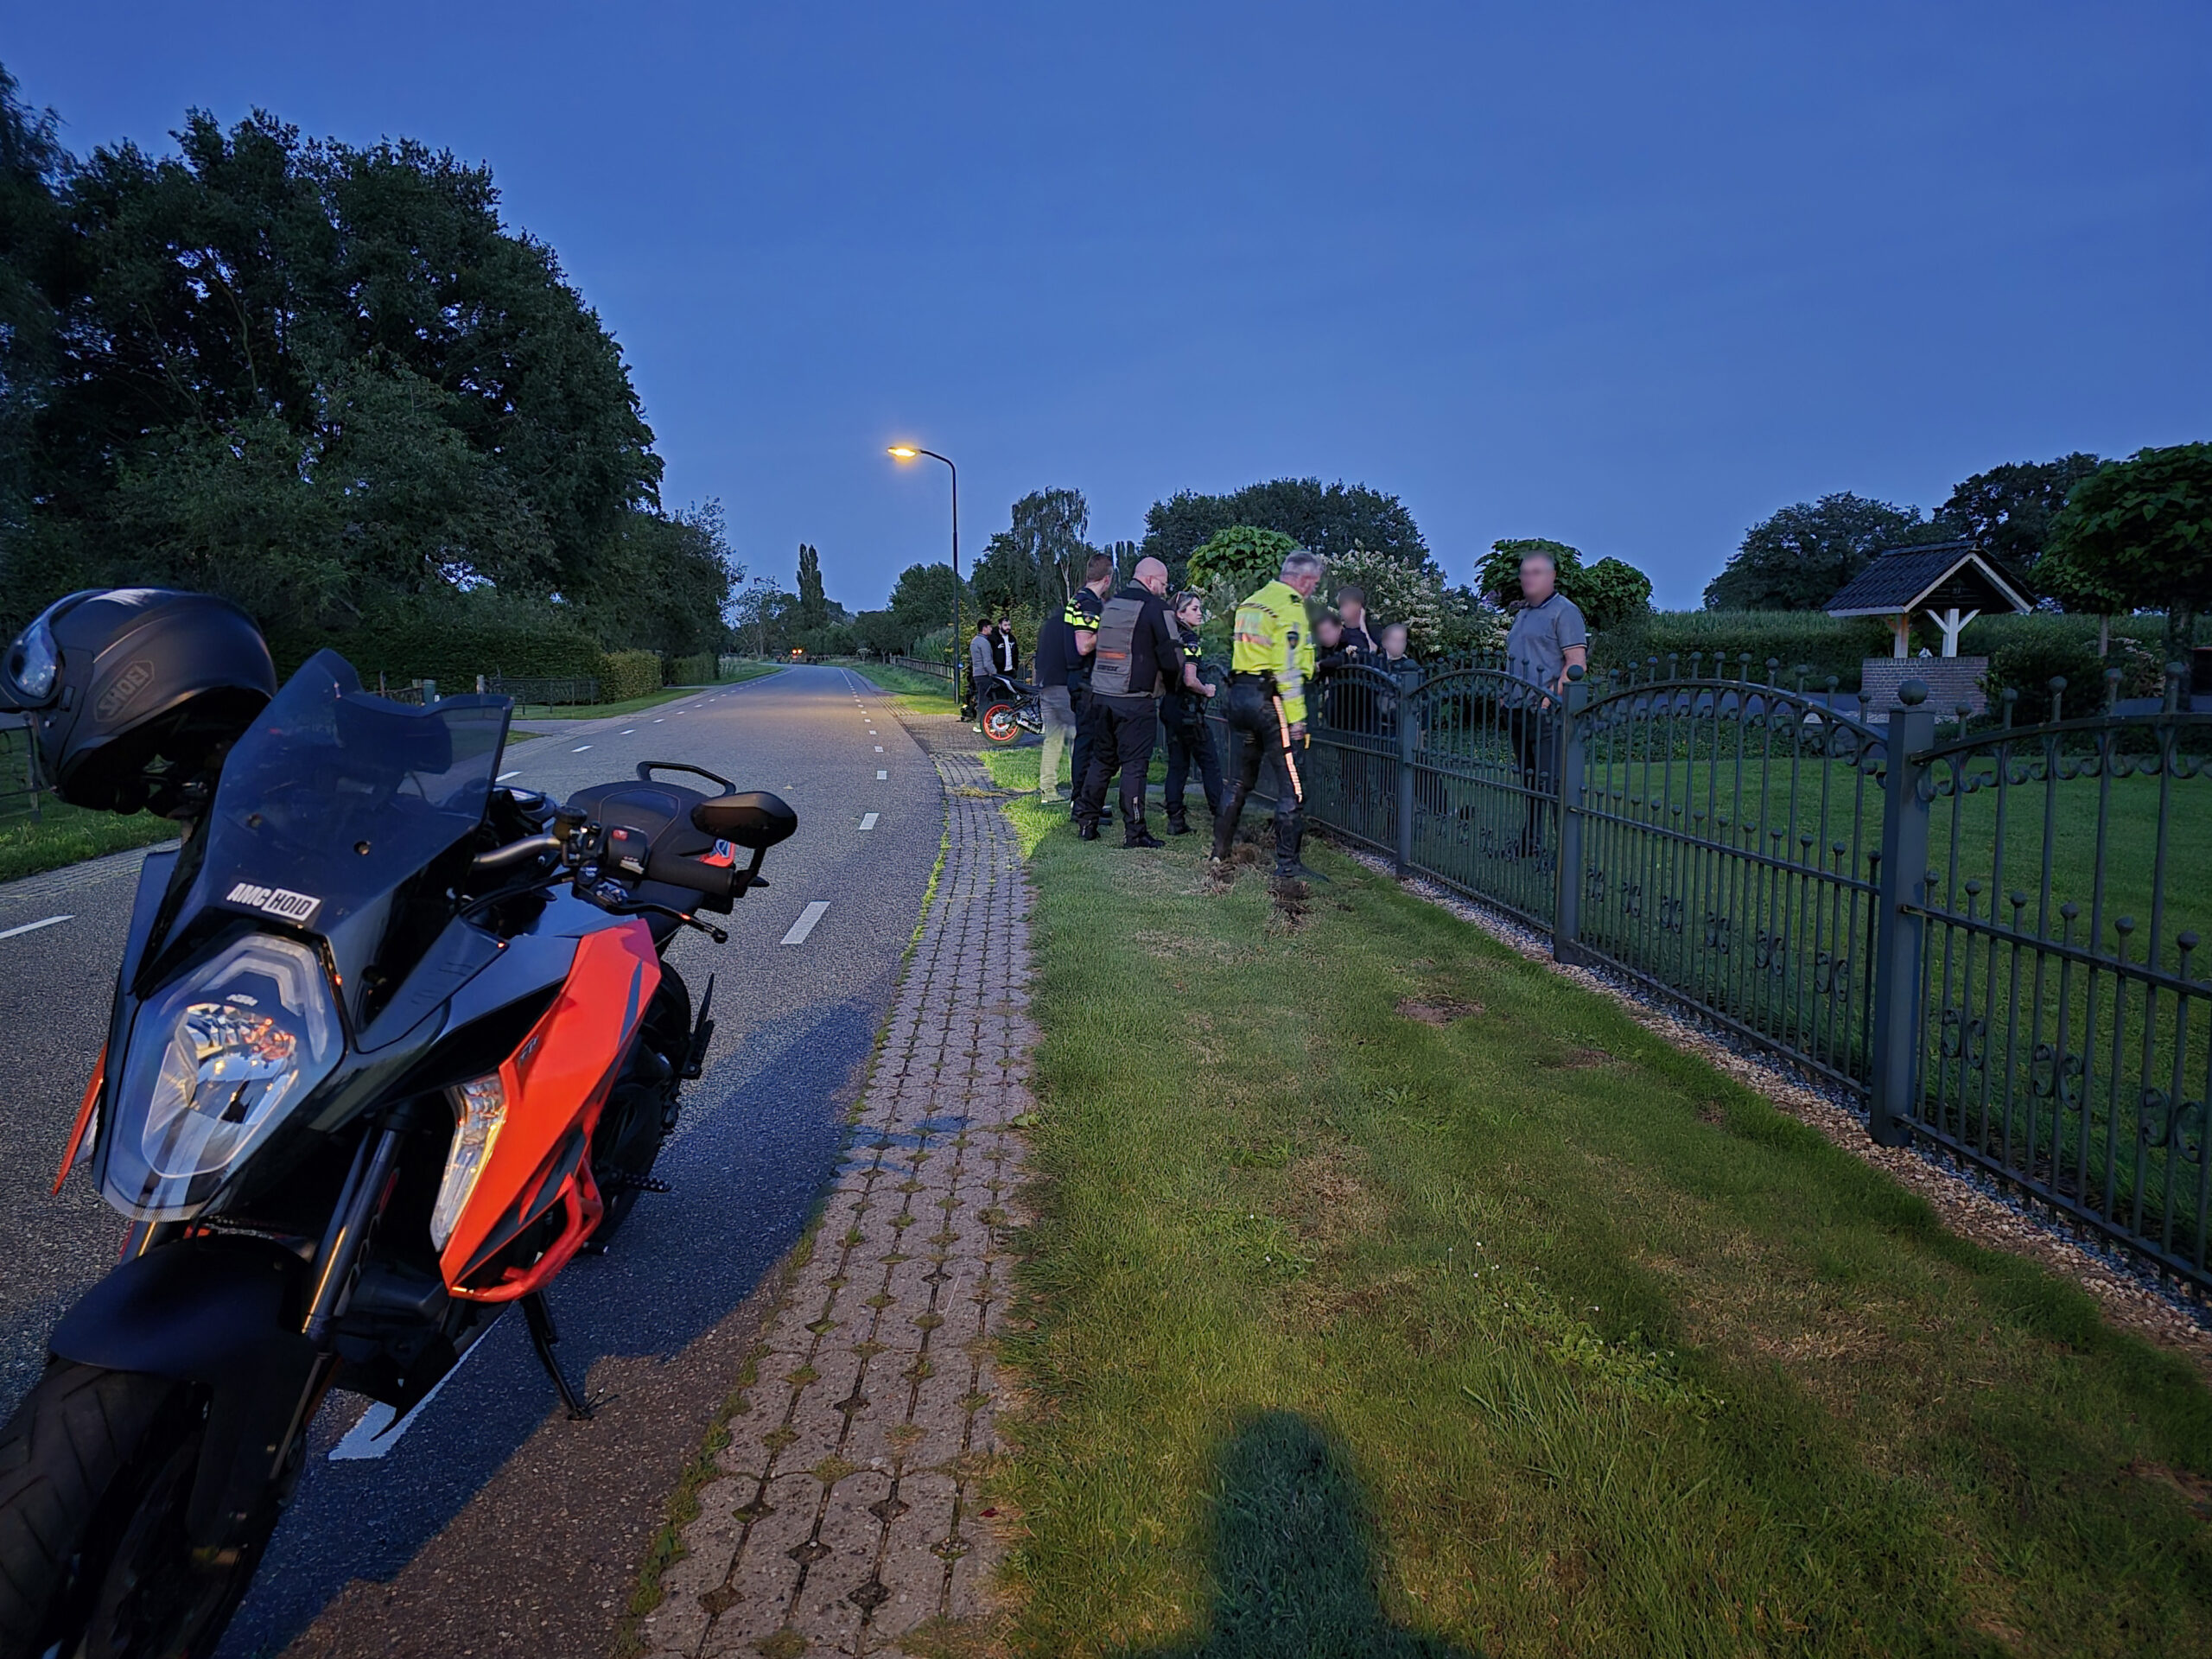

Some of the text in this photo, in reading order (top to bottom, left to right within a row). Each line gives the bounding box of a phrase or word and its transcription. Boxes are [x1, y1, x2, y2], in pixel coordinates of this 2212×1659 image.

[98, 664, 149, 717] SHOEI
[226, 882, 314, 916] AMC HOID
